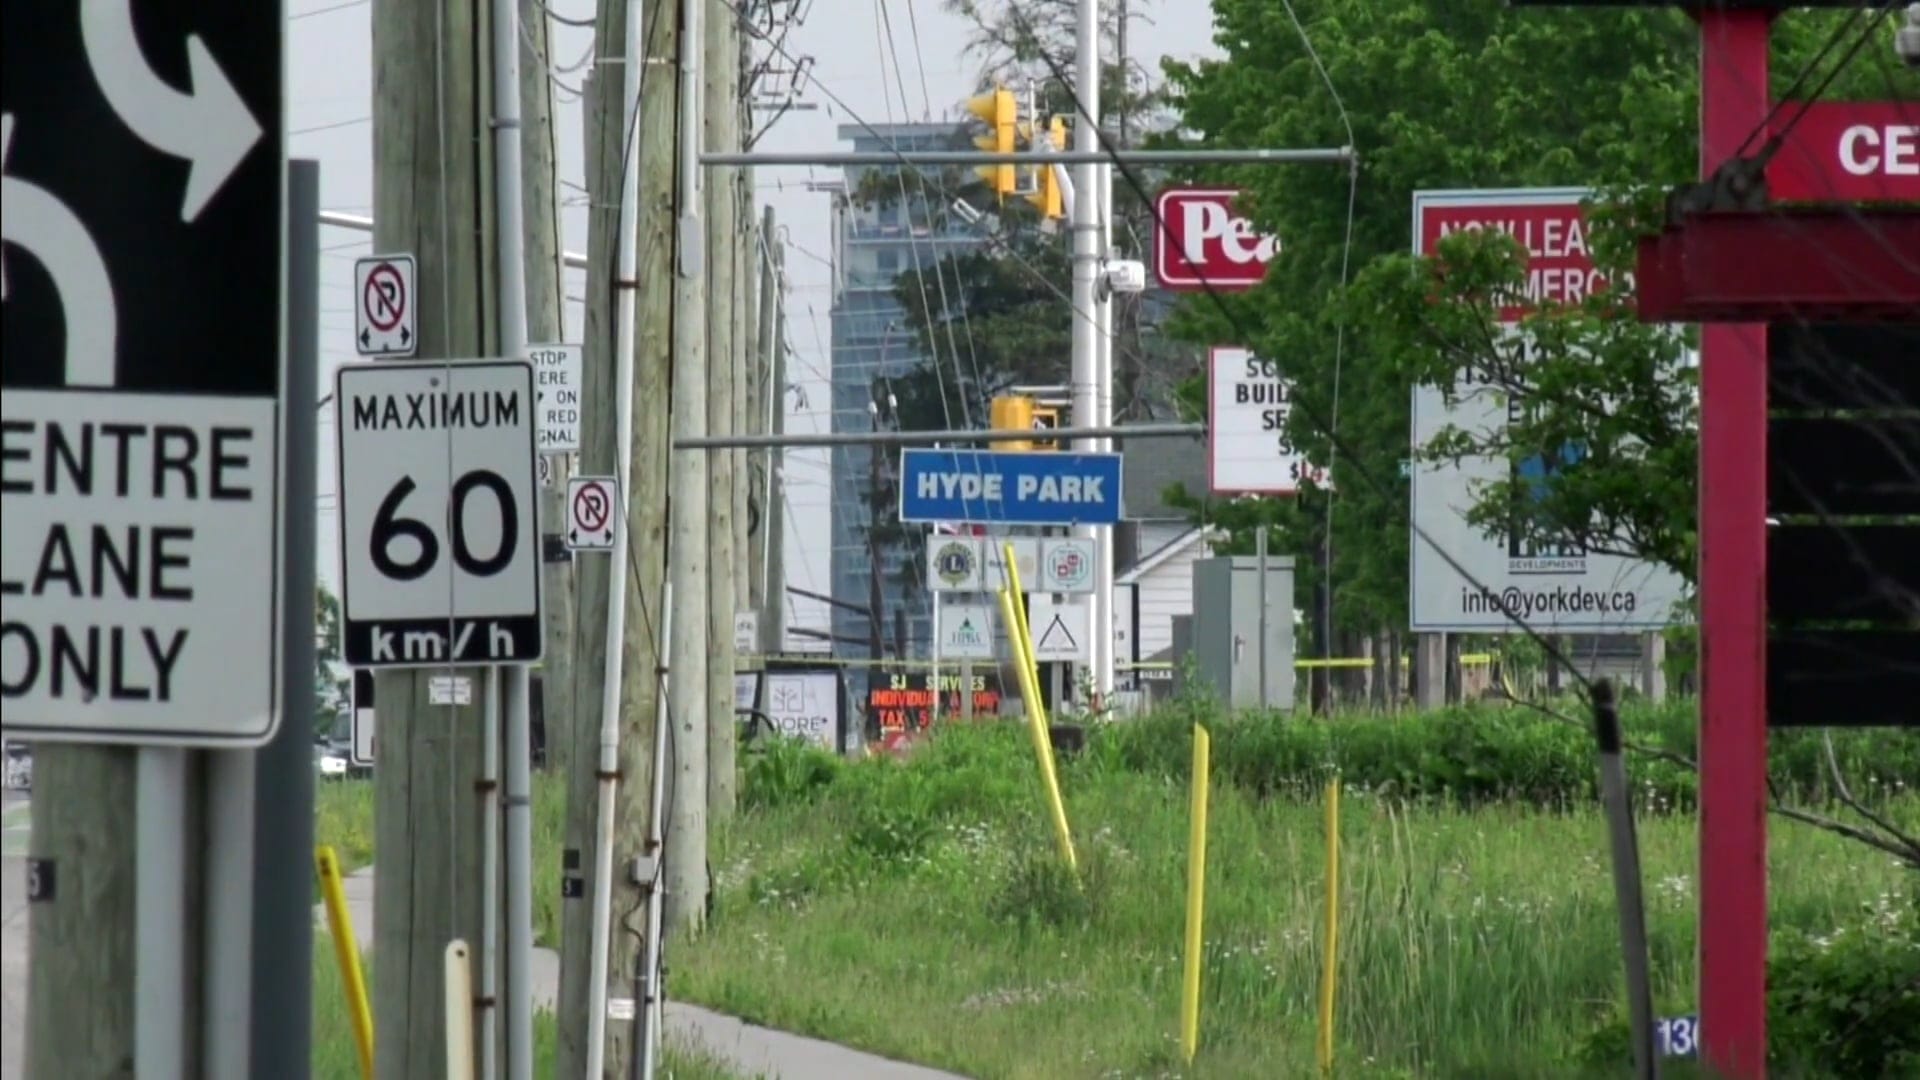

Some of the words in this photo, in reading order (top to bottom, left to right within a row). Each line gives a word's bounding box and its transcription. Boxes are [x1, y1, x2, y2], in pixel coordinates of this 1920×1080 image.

[530, 352, 567, 365] STOP
[539, 371, 568, 385] ERE
[353, 390, 519, 430] MAXIMUM
[556, 390, 577, 404] ON
[547, 409, 577, 423] RED
[1, 420, 253, 502] ENTRE
[917, 472, 1003, 500] HYDE
[1017, 474, 1105, 503] PARK
[369, 468, 519, 581] 60
[1508, 560, 1587, 569] DEVELOPMENTS
[1462, 585, 1636, 621] info@yorkdev.ca
[370, 625, 515, 662] km/h
[1, 621, 190, 703] ONLY
